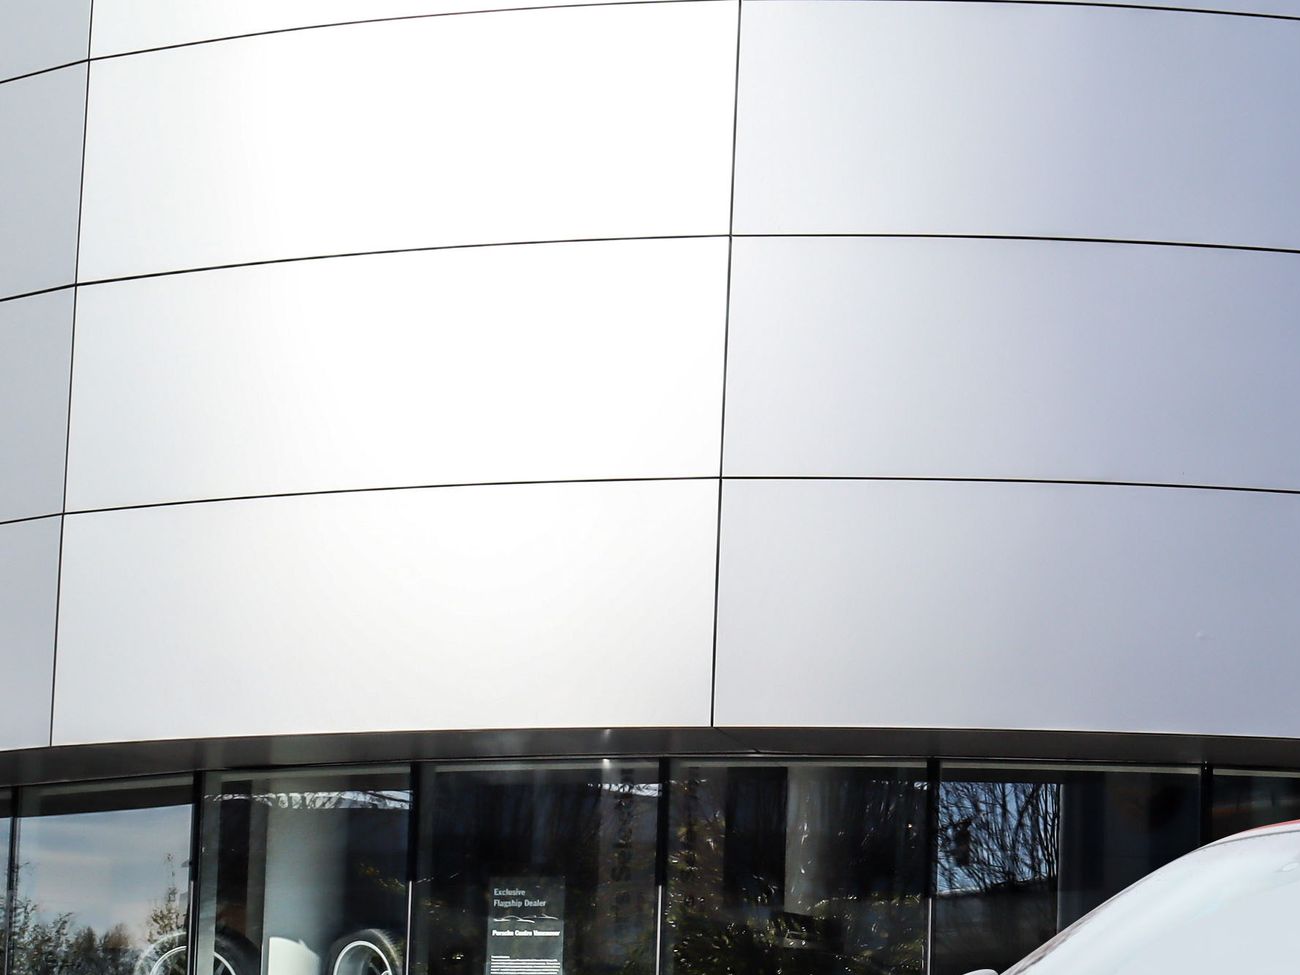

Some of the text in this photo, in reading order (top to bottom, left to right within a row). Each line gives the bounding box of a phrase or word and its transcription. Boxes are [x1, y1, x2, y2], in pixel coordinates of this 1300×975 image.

[493, 888, 526, 896] Exclusive
[493, 899, 547, 908] Flagship Dealer
